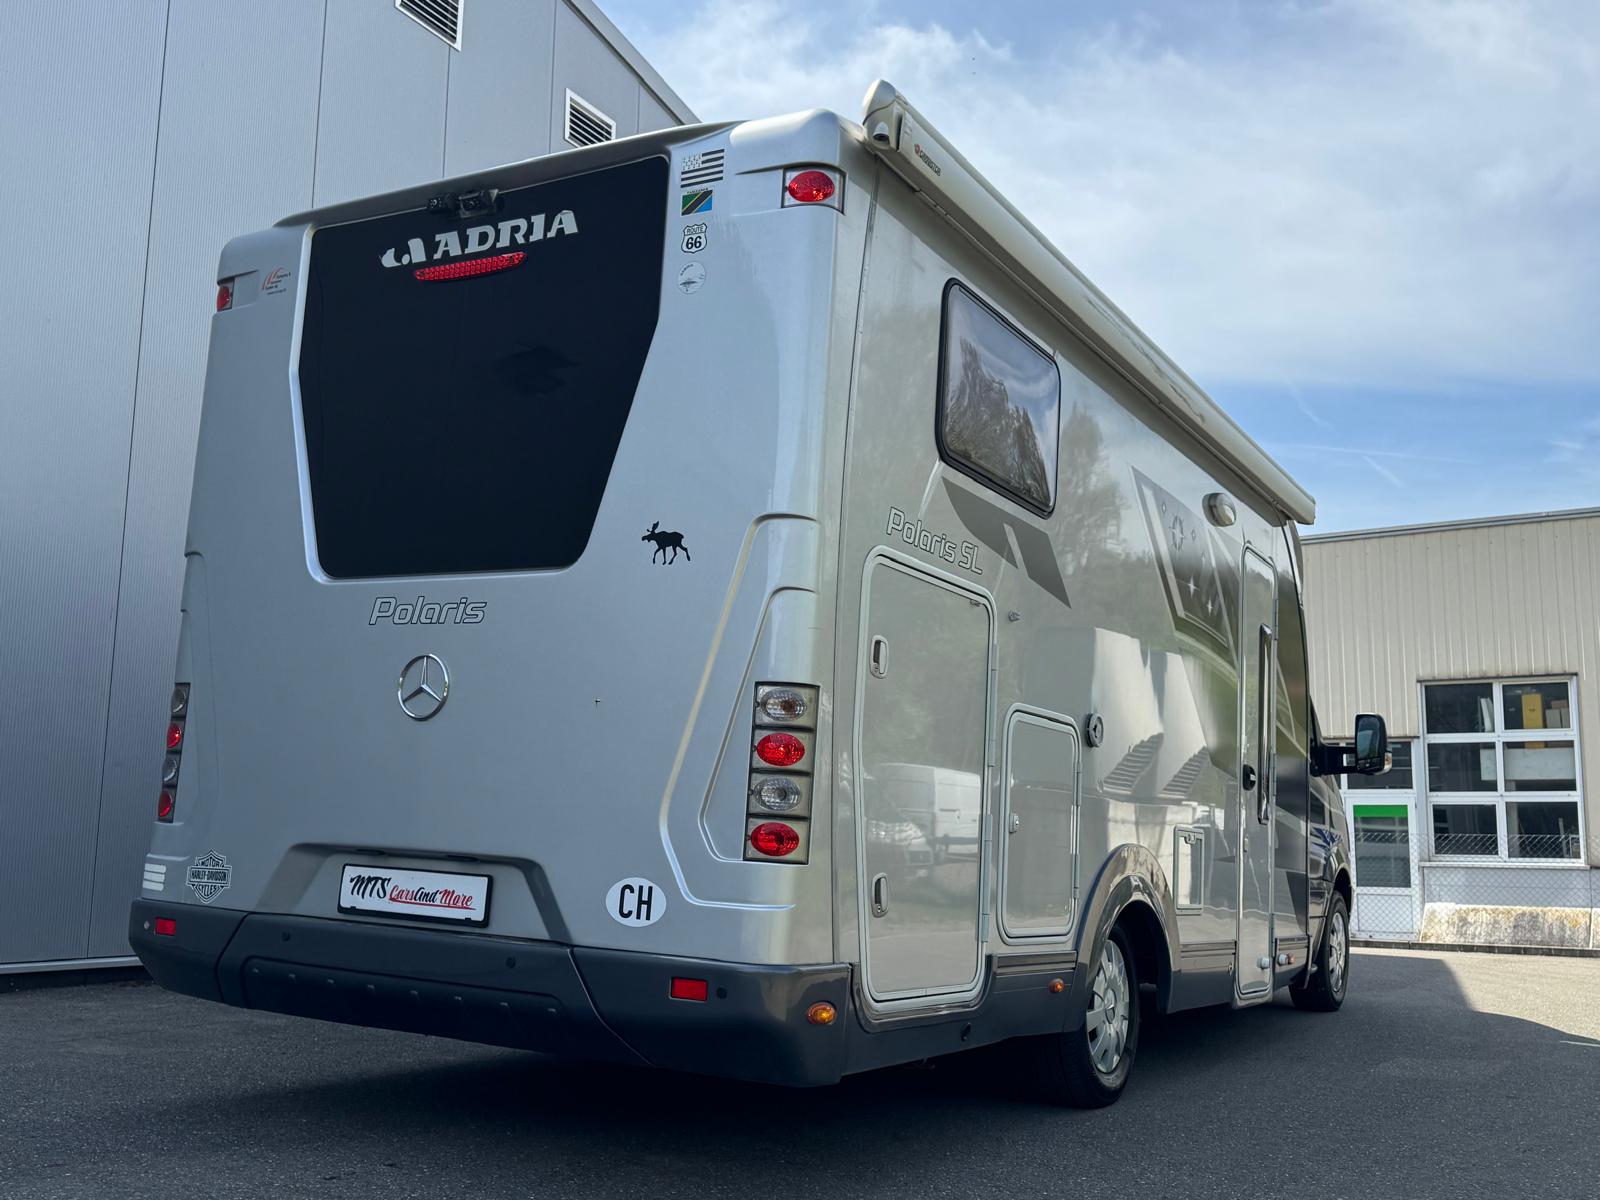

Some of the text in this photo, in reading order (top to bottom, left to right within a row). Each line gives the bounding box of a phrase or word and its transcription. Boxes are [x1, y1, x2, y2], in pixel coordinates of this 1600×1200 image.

[433, 209, 579, 260] ADRIA
[686, 225, 704, 234] ROUTE
[686, 235, 702, 250] 66
[886, 506, 983, 576] Polaris SL
[368, 595, 488, 625] Polaris
[350, 874, 392, 900] MTS
[618, 883, 654, 921] CH
